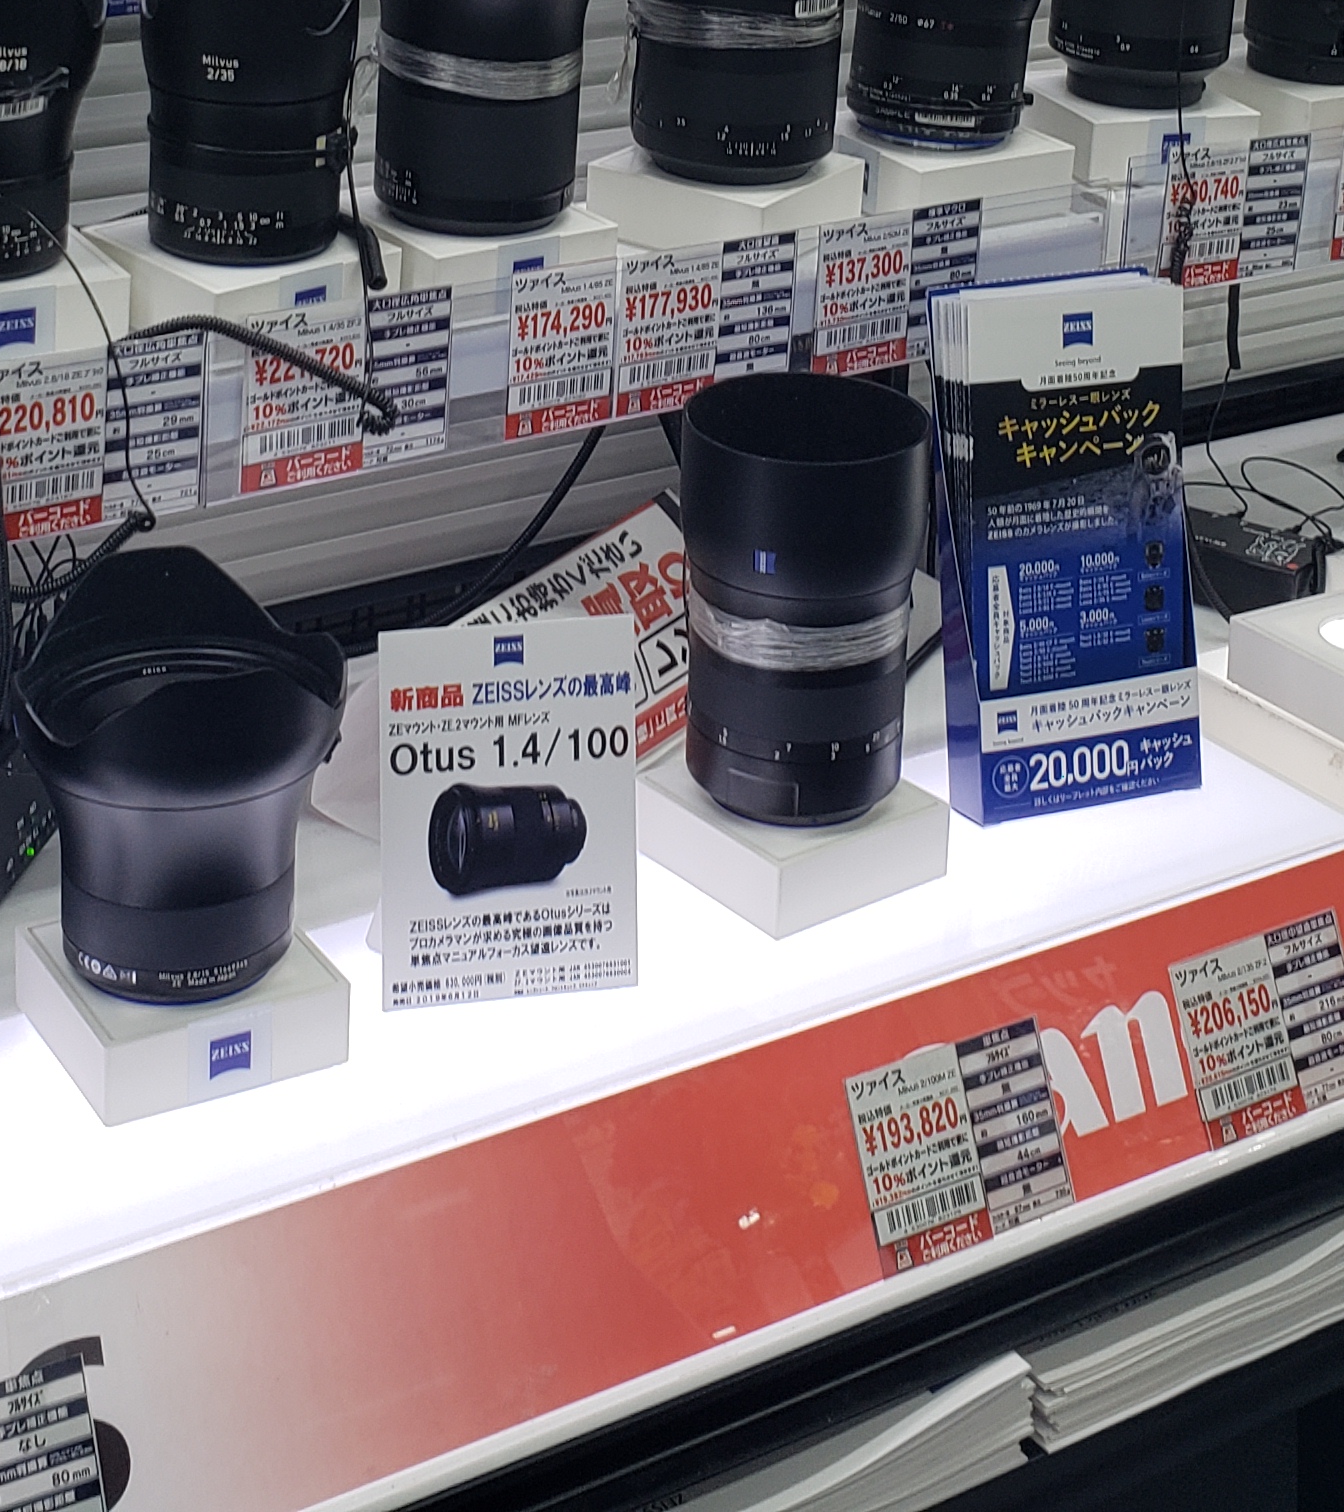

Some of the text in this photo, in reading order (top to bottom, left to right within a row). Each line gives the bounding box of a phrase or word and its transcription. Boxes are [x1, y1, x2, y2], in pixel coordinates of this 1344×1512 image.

[202, 53, 239, 68] Milvus
[206, 67, 235, 83] 2/35
[1063, 320, 1092, 333] ZEISS
[998, 400, 1160, 441] キャッシュバック
[1017, 433, 1144, 468] キャンペーン
[494, 642, 523, 654] ZEISS
[390, 673, 631, 712] 新商品 ZEISSレンズの最高峰
[390, 724, 629, 776] Otus 1.4/100
